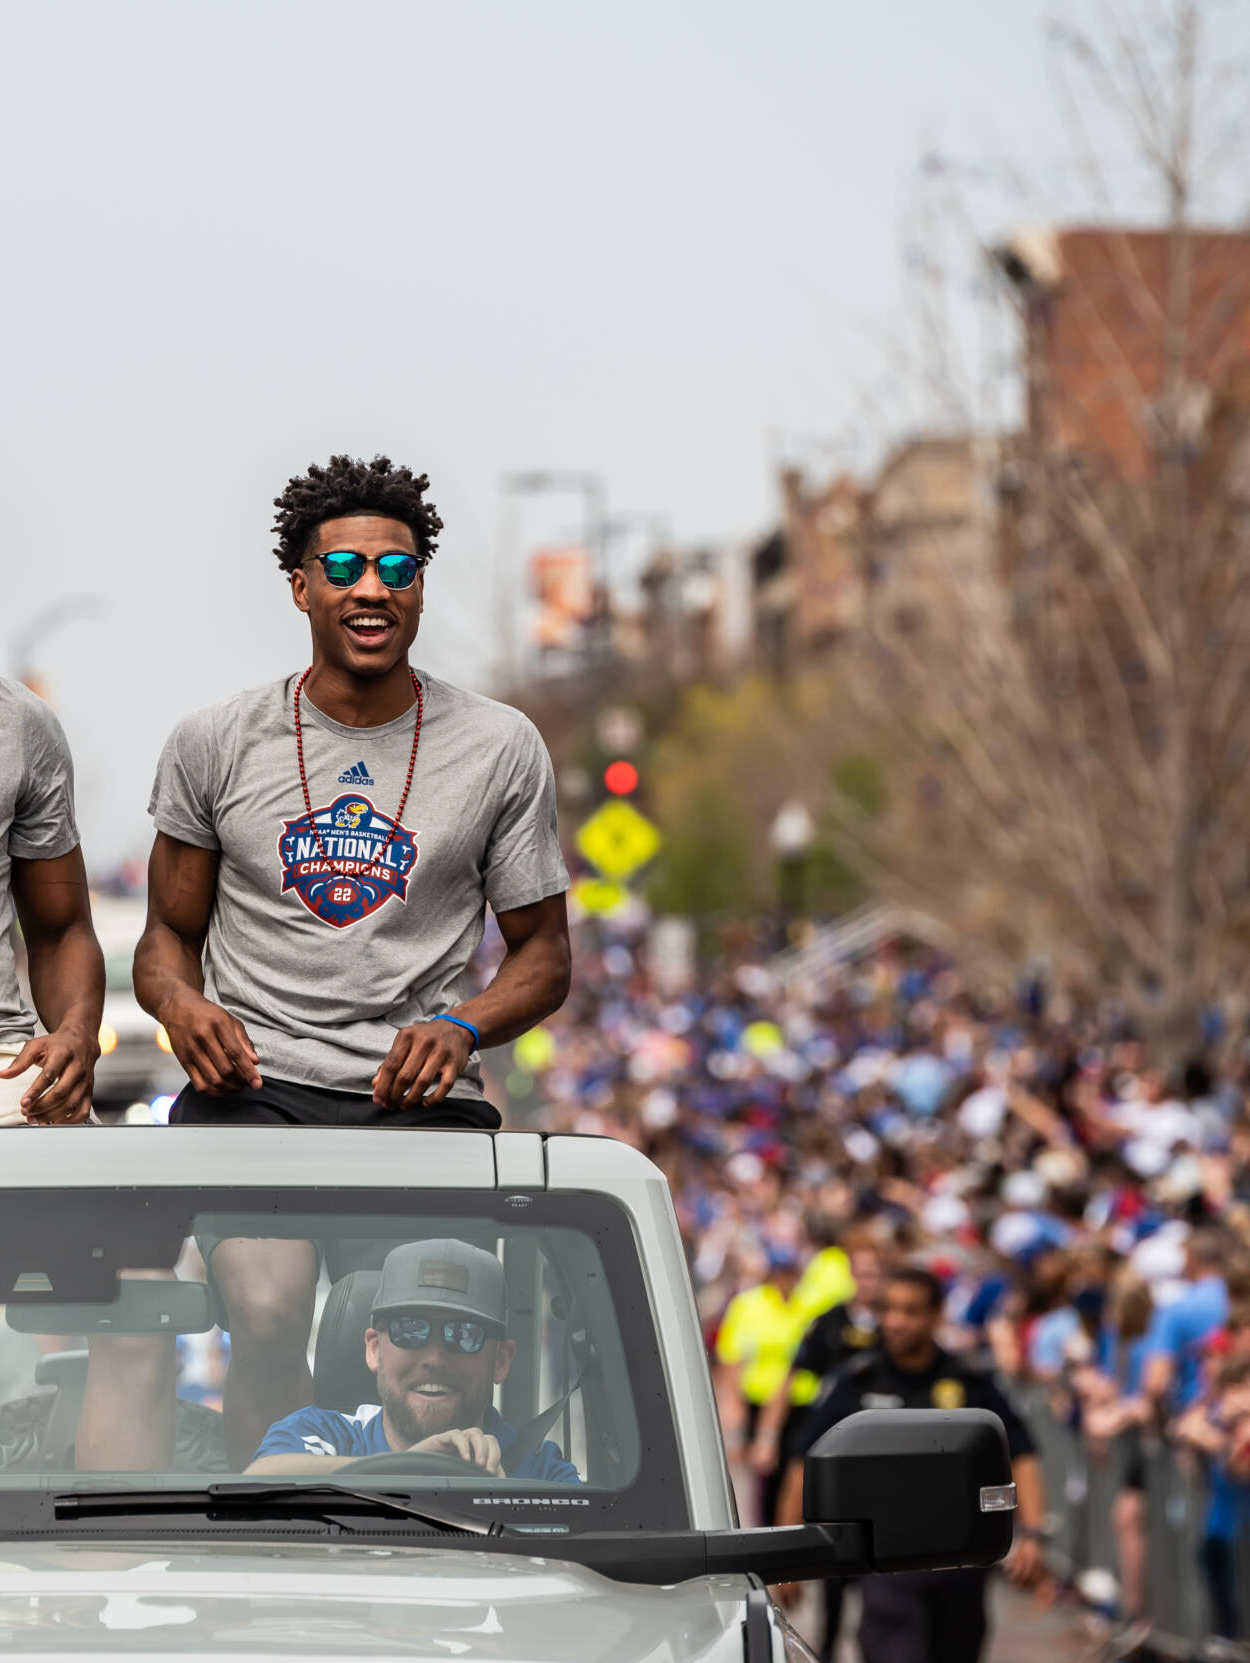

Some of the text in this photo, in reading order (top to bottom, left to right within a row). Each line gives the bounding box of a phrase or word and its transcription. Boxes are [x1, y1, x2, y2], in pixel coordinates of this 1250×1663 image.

[338, 775, 375, 786] adidas
[295, 836, 397, 867] NATIONAL
[300, 860, 391, 881] CHAMPIONS
[333, 887, 351, 902] 22
[472, 1497, 590, 1506] BRONCO
